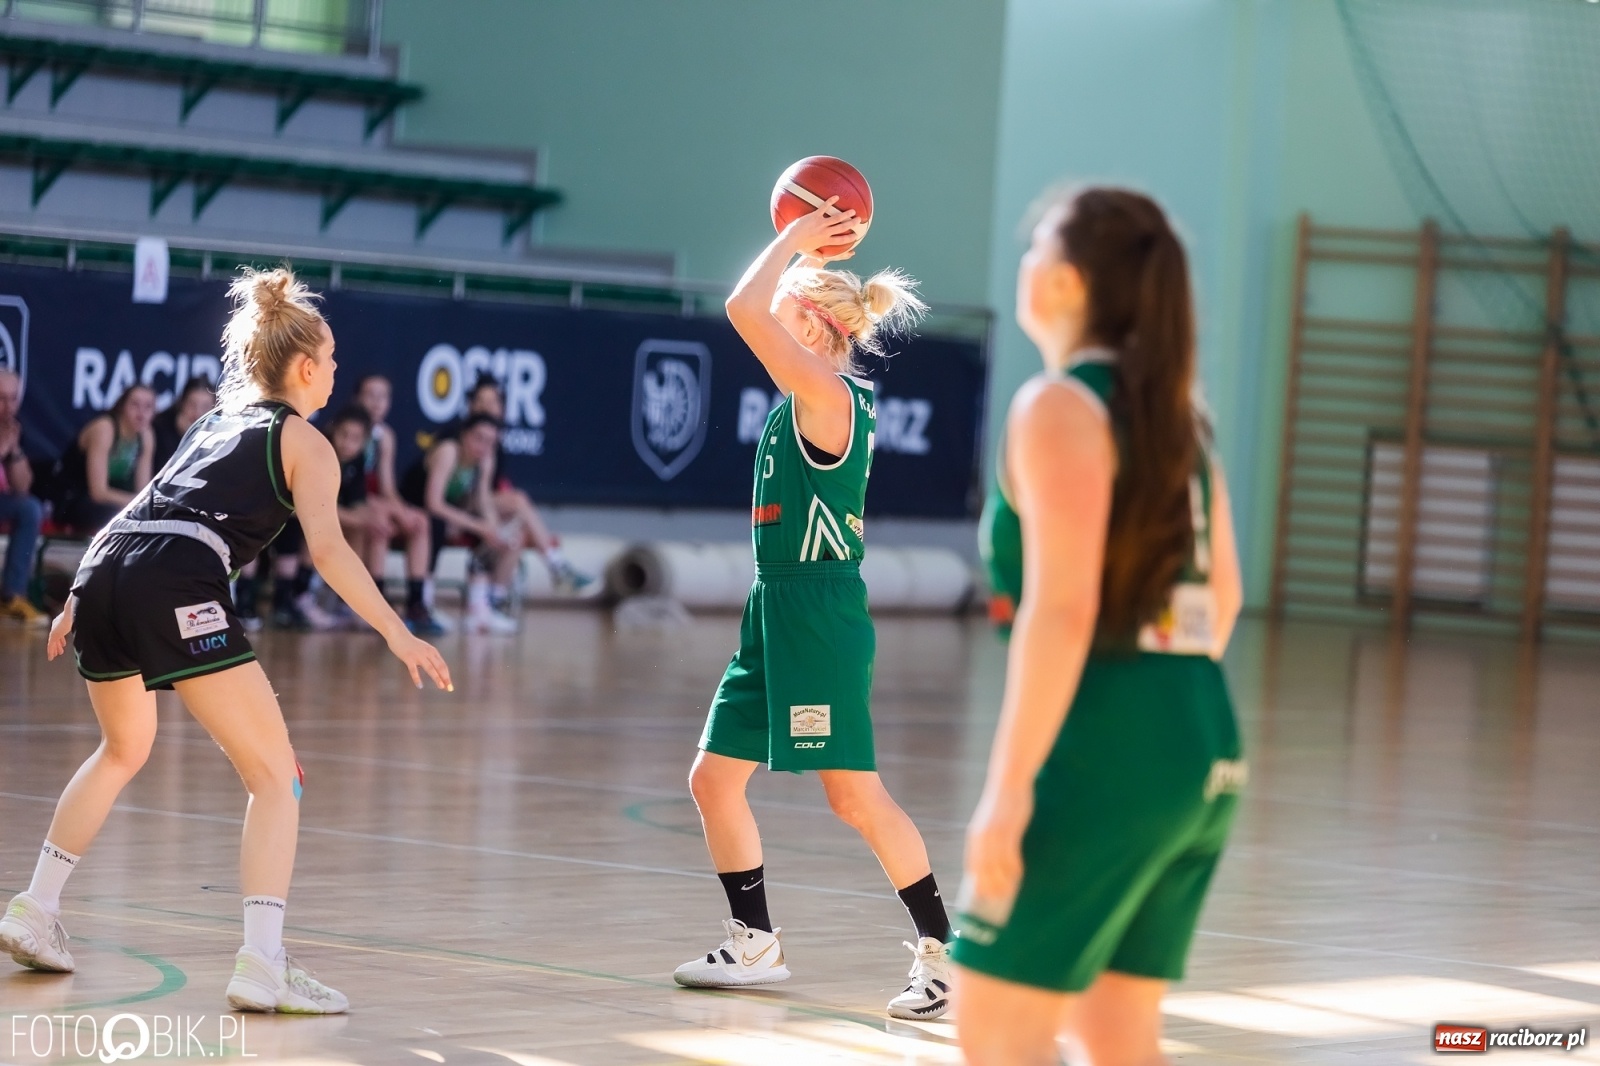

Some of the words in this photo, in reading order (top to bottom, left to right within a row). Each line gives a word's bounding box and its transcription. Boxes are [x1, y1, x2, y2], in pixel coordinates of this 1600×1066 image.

[189, 633, 228, 655] LUCY
[794, 741, 826, 749] COLO
[52, 850, 78, 866] SPAL
